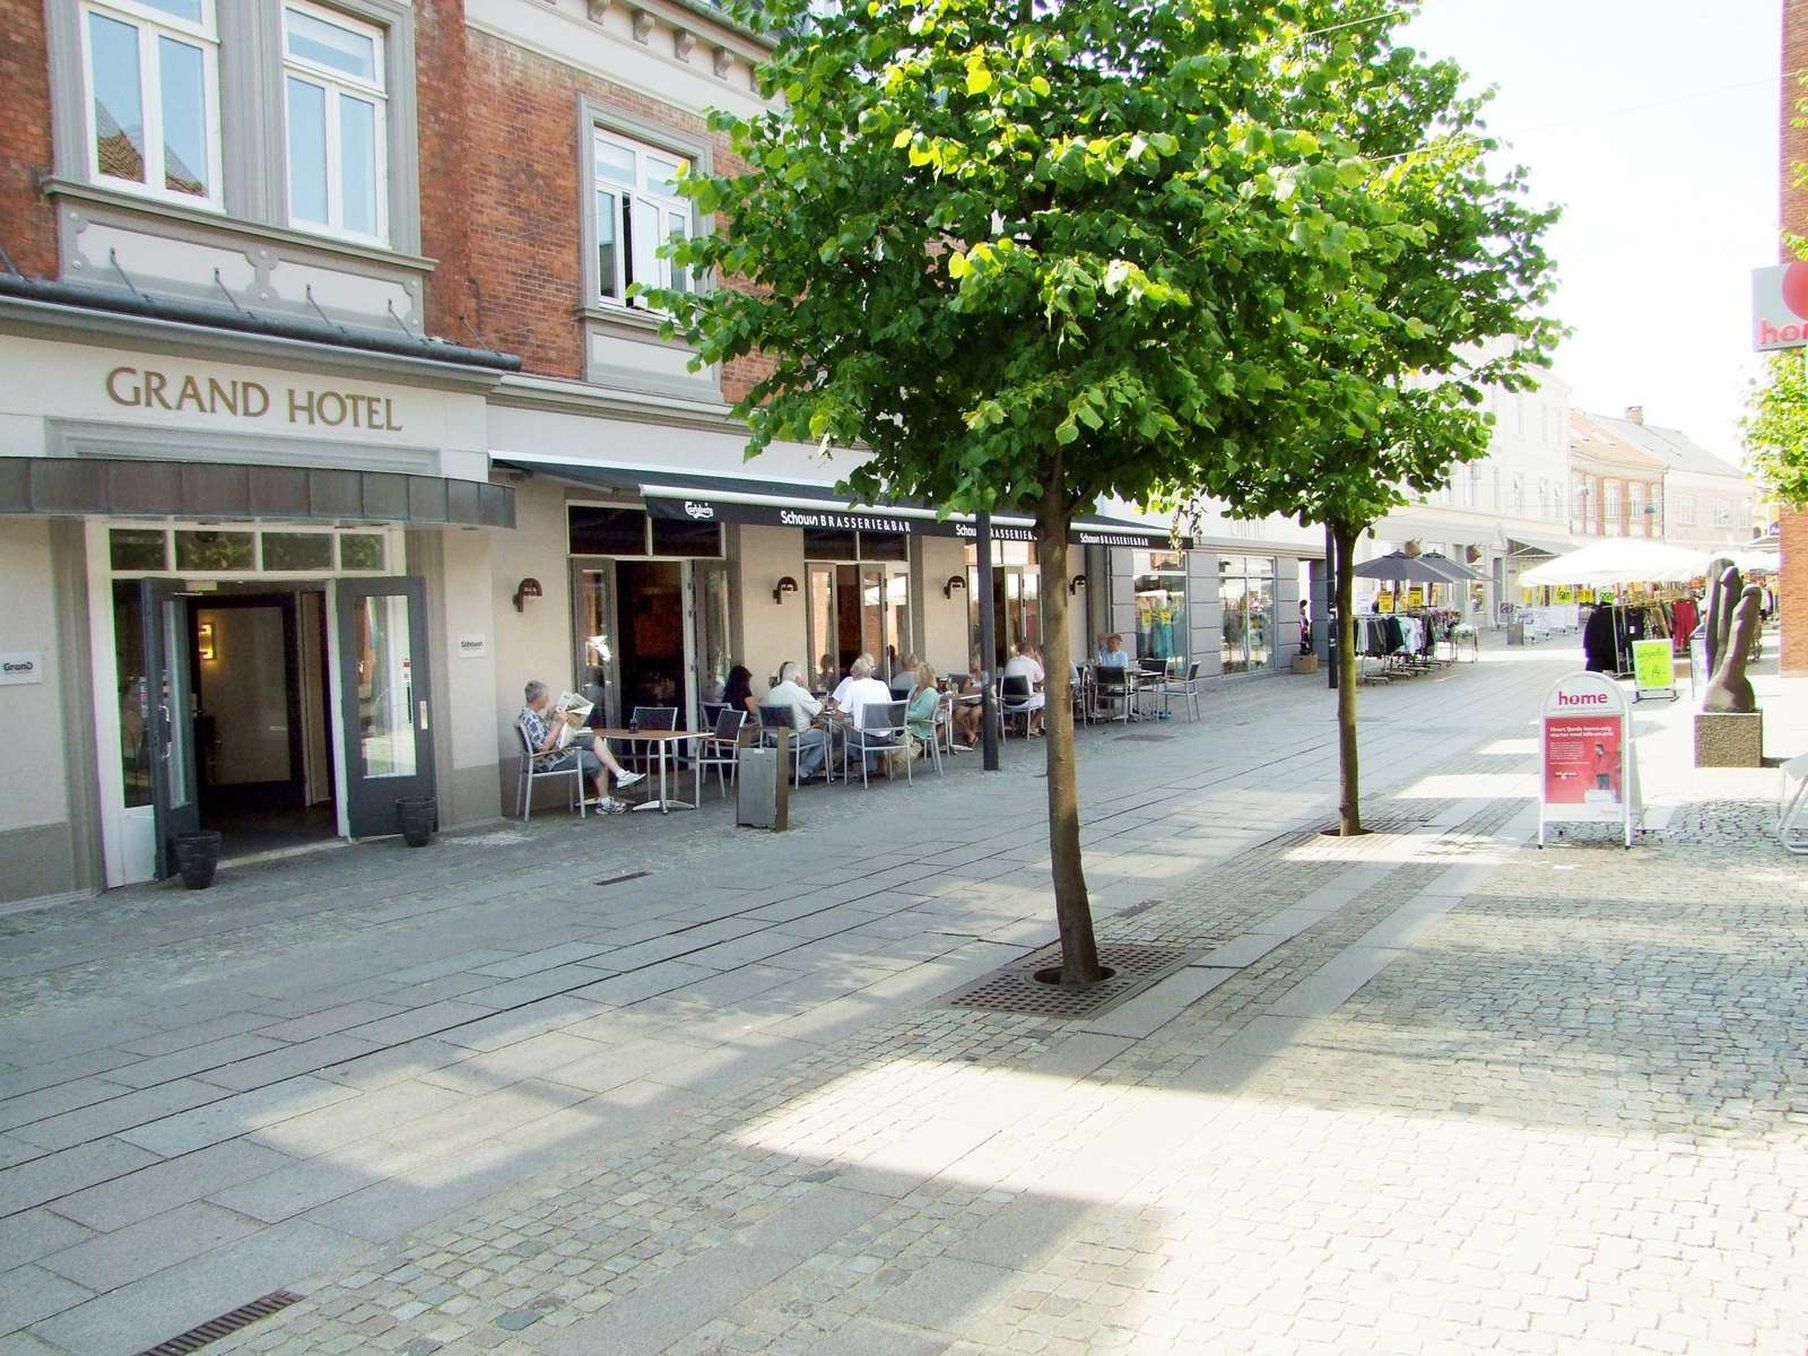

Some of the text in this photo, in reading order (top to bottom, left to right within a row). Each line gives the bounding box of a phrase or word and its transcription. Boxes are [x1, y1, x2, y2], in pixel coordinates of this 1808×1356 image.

[1759, 318, 1808, 345] ho
[105, 366, 404, 432] GRAND HOTEL
[820, 514, 911, 533] BRASSERIE&BAR
[1558, 690, 1608, 706] home
